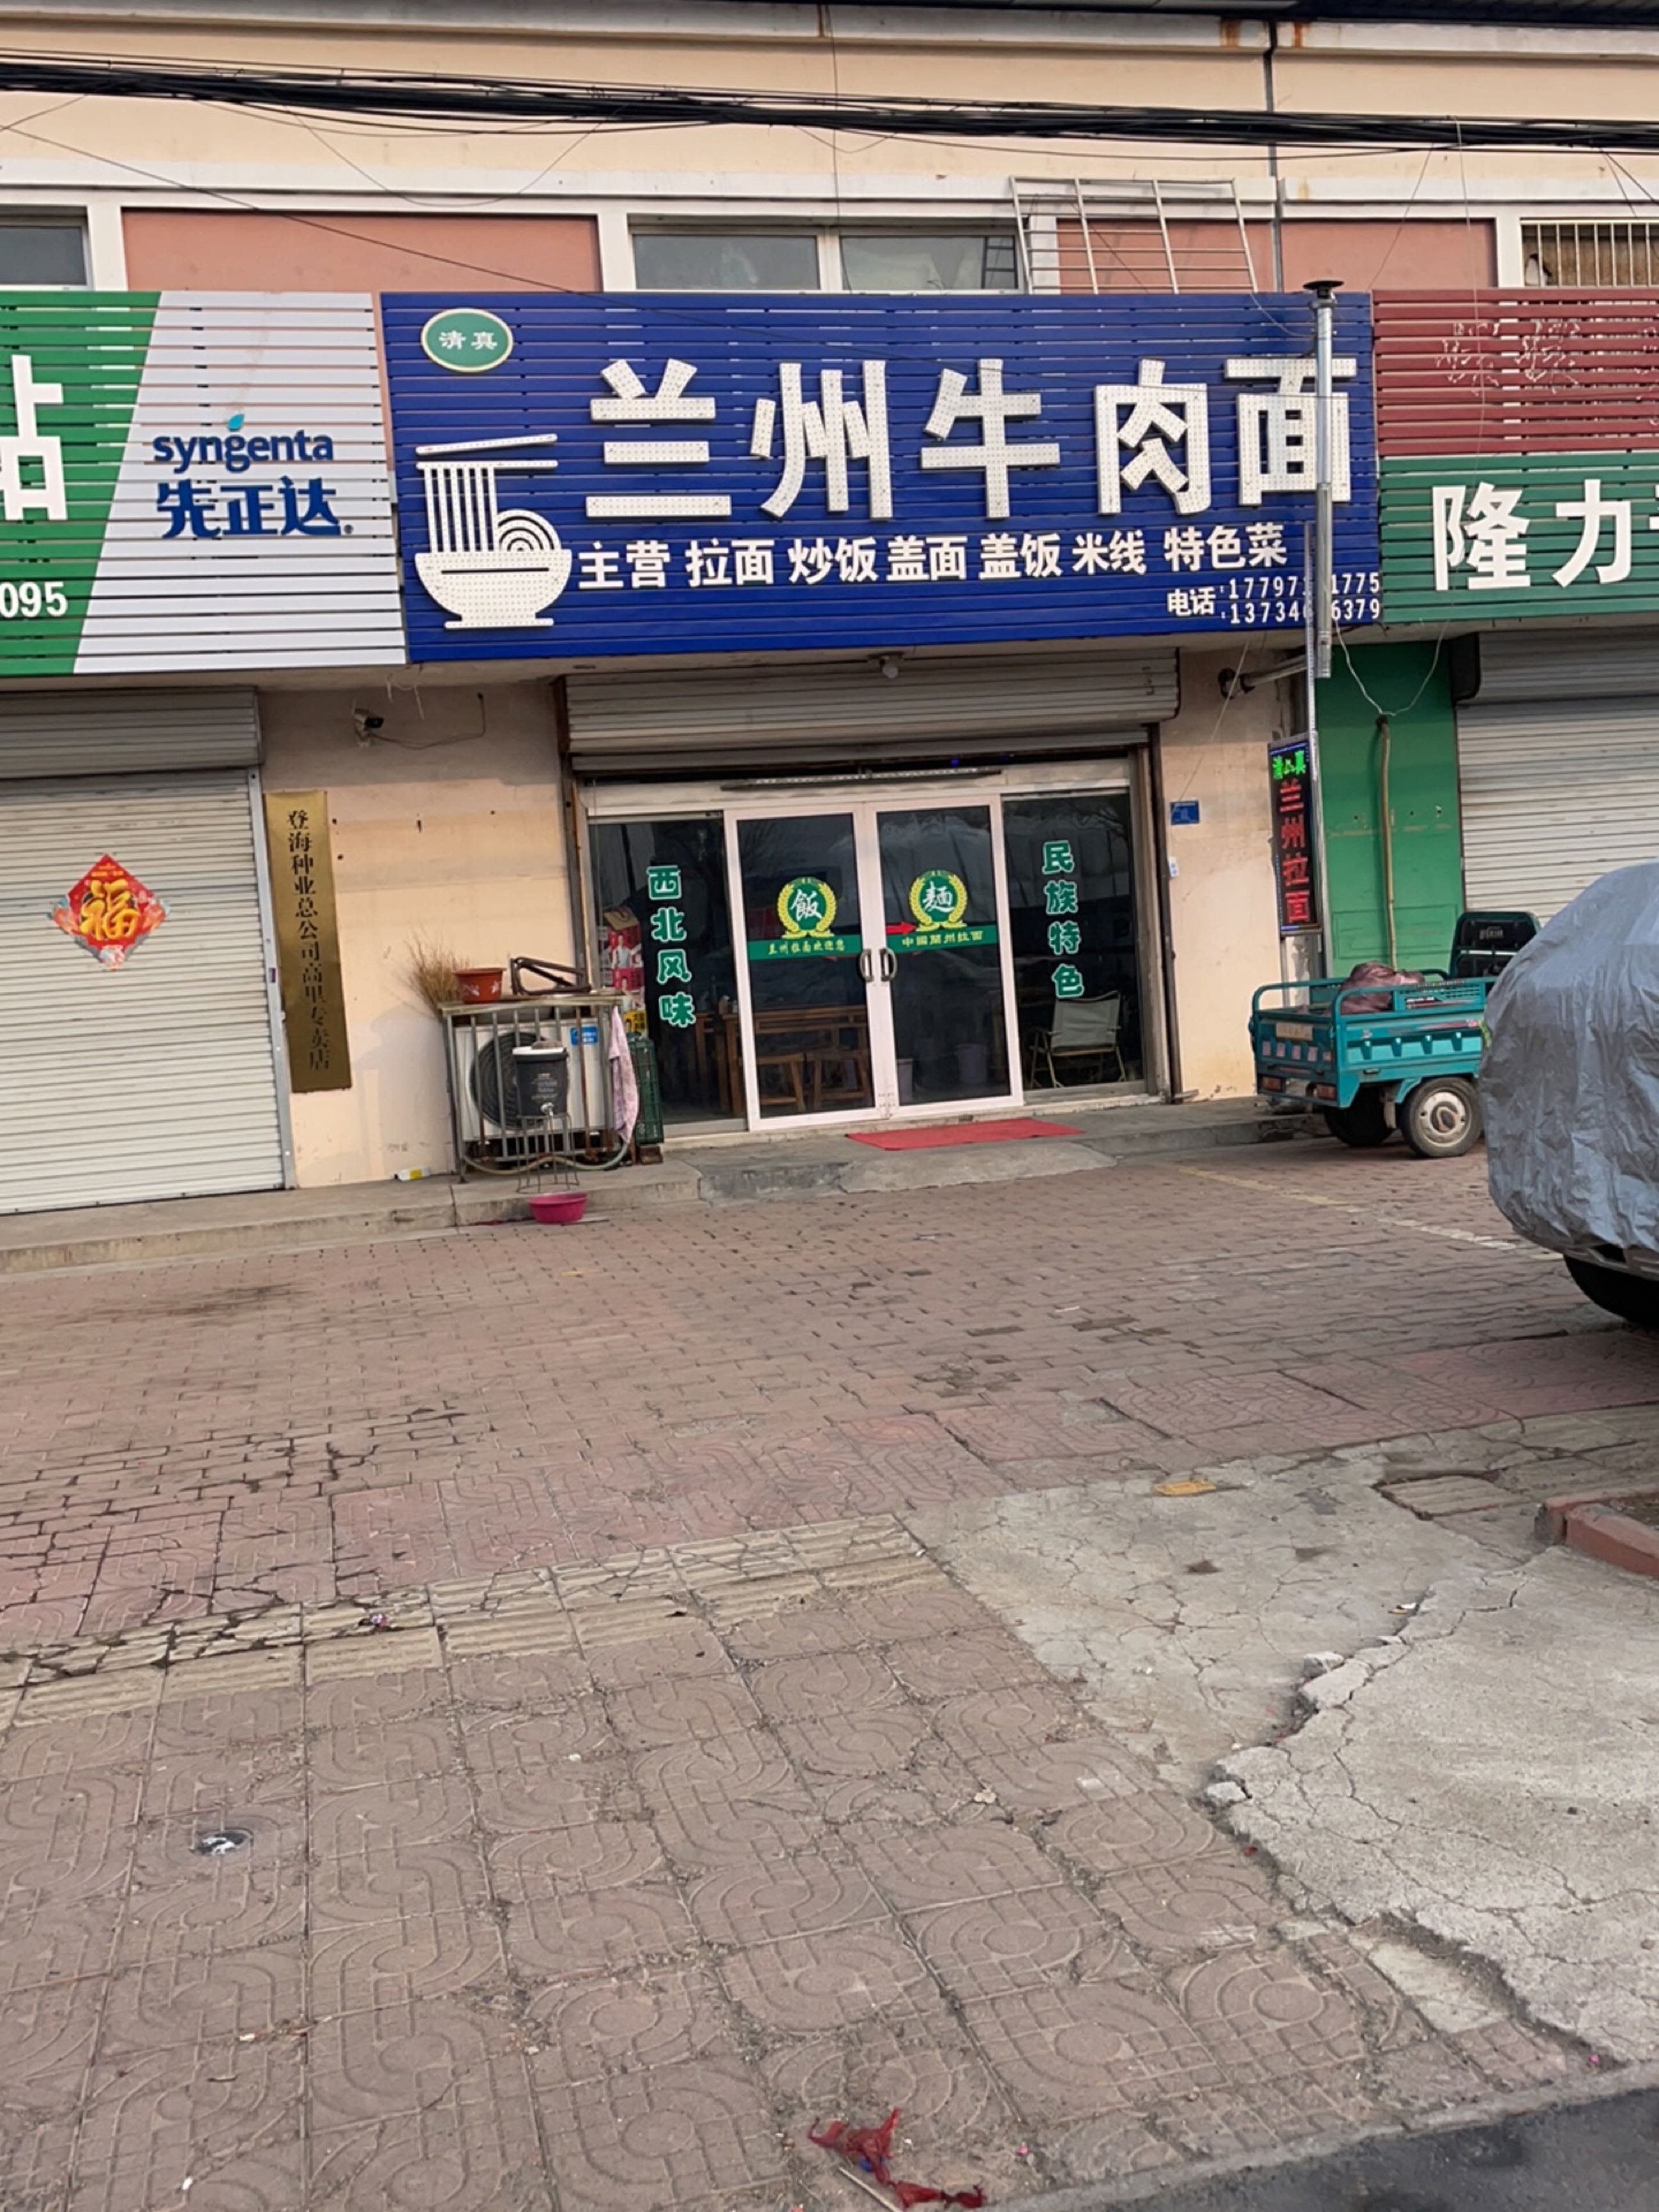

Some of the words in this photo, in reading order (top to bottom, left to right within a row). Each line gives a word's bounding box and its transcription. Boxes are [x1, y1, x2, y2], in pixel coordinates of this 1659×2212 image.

[439, 332, 497, 351] 清真
[152, 429, 333, 474] syngenta
[585, 358, 1358, 520] 兰州牛肉面
[156, 476, 341, 539] 先正达
[1432, 479, 1659, 591] 隆力
[578, 541, 671, 589] 主营
[685, 538, 774, 586] 拉面
[788, 537, 878, 584] 炒饭
[886, 536, 968, 581] 盖面
[979, 533, 1062, 577] 盖饭
[1072, 531, 1146, 575] 米线
[1164, 522, 1287, 572] 特色菜
[1167, 587, 1215, 616] 电话
[1280, 778, 1310, 922] 兰州拉面
[80, 879, 140, 941] 福
[1043, 840, 1084, 998] 民族特色
[646, 865, 696, 1027] 西北风味
